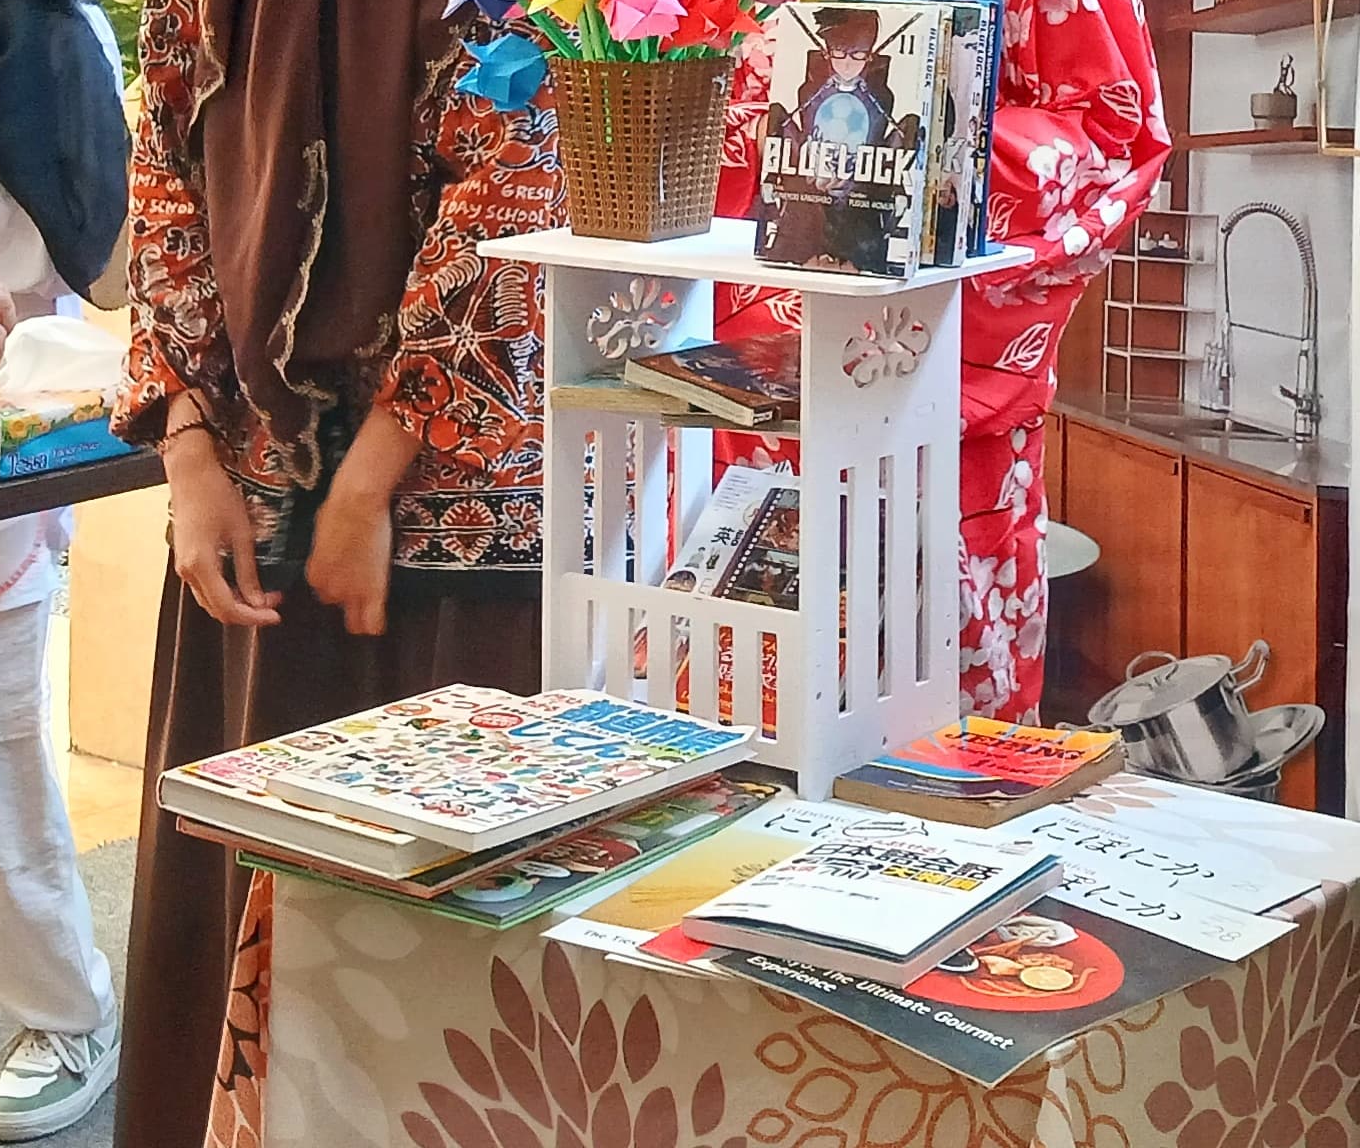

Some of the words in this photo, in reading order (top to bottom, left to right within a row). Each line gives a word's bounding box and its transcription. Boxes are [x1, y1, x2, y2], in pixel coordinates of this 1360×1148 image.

[508, 719, 631, 759] じてん
[805, 843, 1003, 881] 日本語会話
[746, 954, 838, 993] Experience
[823, 968, 854, 985] The
[856, 979, 932, 1017] Ultimate
[934, 1010, 1016, 1051] Gourmet
